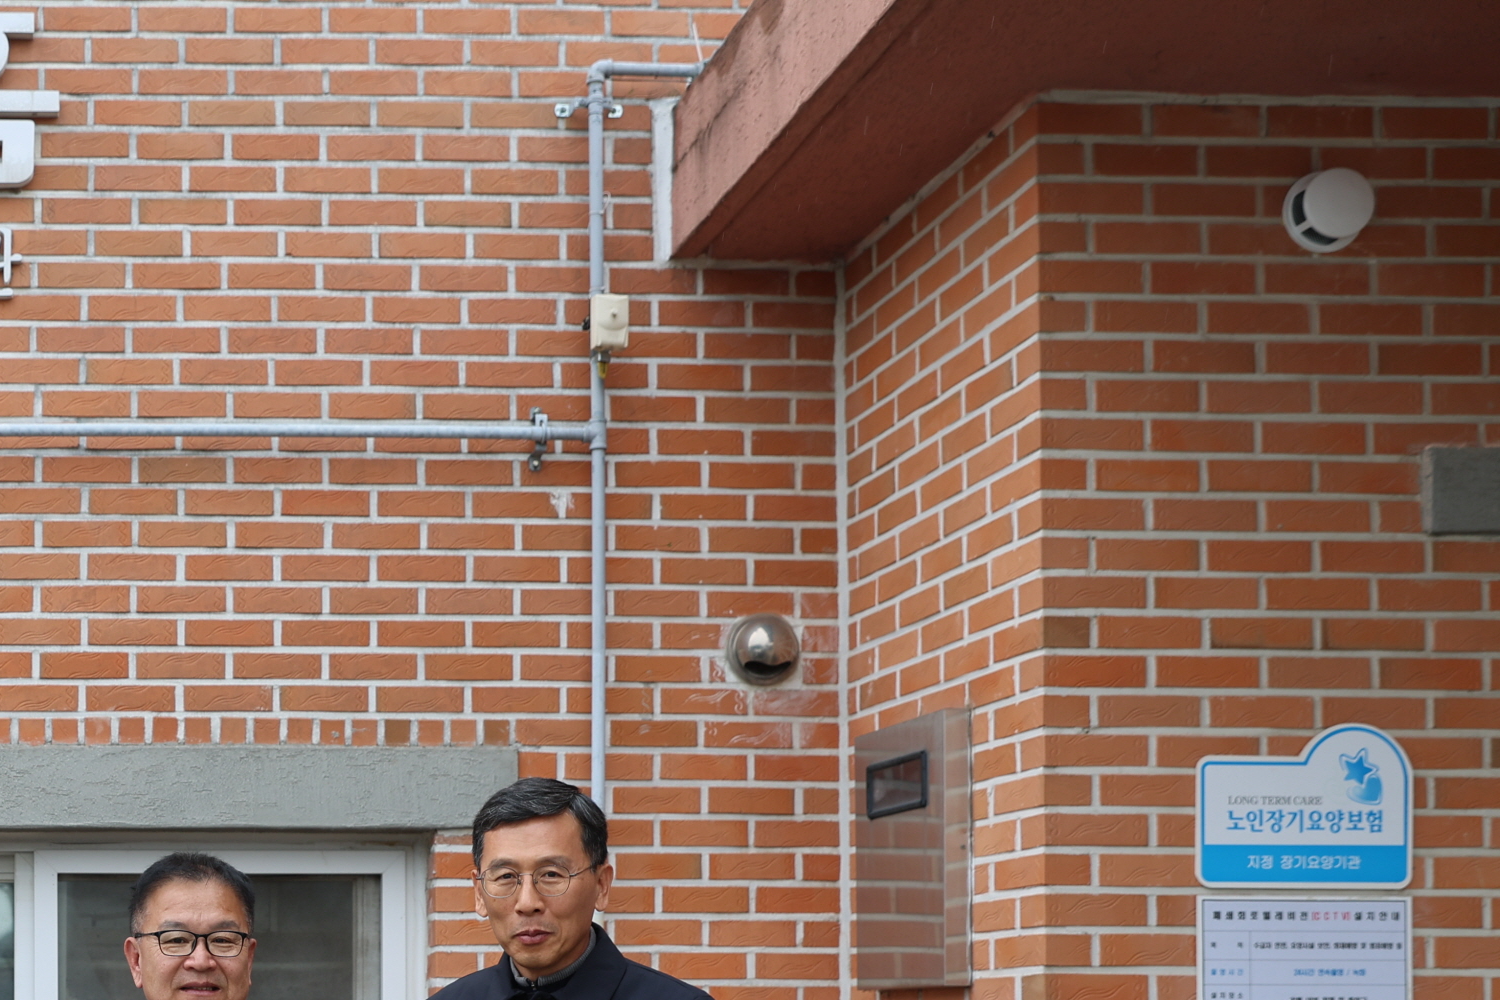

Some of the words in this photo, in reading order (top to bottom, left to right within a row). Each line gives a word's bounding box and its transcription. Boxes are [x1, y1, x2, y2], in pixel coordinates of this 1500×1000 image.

[1228, 795, 1259, 806] LONG
[1261, 795, 1292, 806] TERM
[1293, 795, 1323, 806] CARE
[1226, 809, 1384, 834] 노인장기요양보험
[1247, 855, 1274, 870] 지정
[1280, 855, 1362, 870] 장기요양기관
